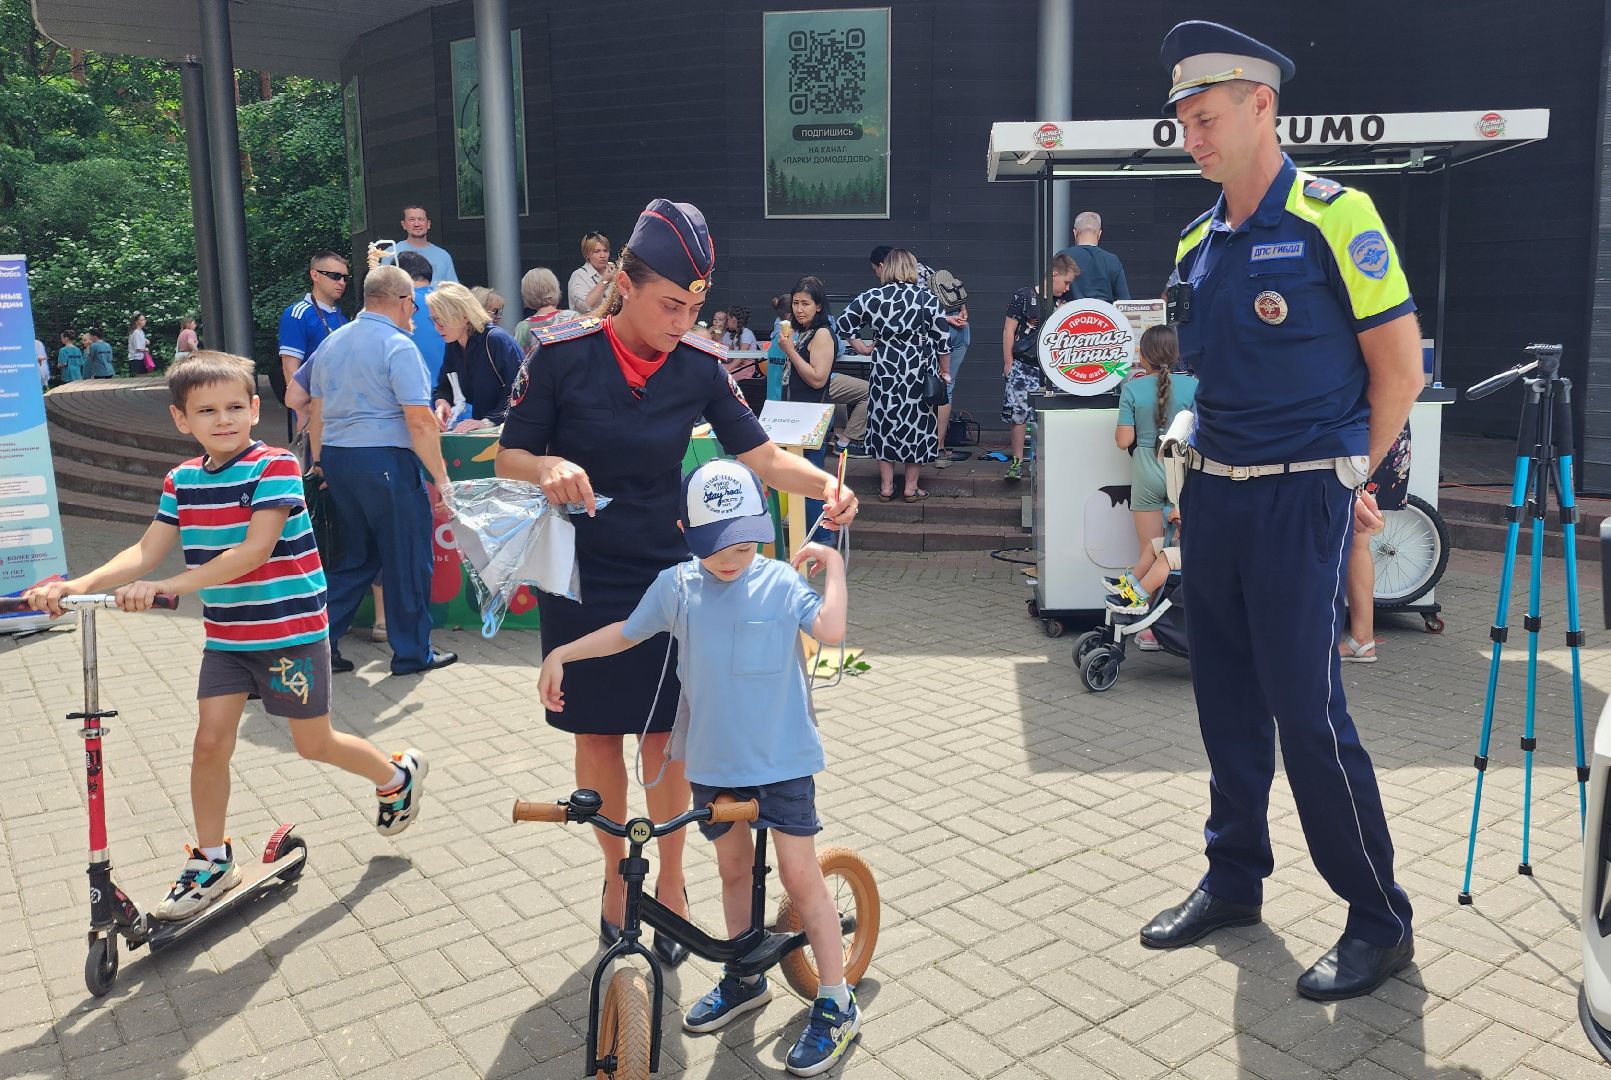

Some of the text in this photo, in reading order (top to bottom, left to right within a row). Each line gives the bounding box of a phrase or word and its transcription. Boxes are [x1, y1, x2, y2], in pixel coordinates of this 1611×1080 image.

[801, 128, 854, 138] ПОДПИШИСЬ
[821, 146, 848, 154] КАНАЛ
[1254, 244, 1300, 257] ДПС ГИБДД
[1068, 316, 1109, 329] ПРОДУКТ
[1043, 330, 1132, 350] Чистая
[1049, 347, 1128, 368] Линия
[1069, 368, 1105, 379] trade mark
[703, 491, 724, 507] Stay
[633, 828, 647, 836] hb
